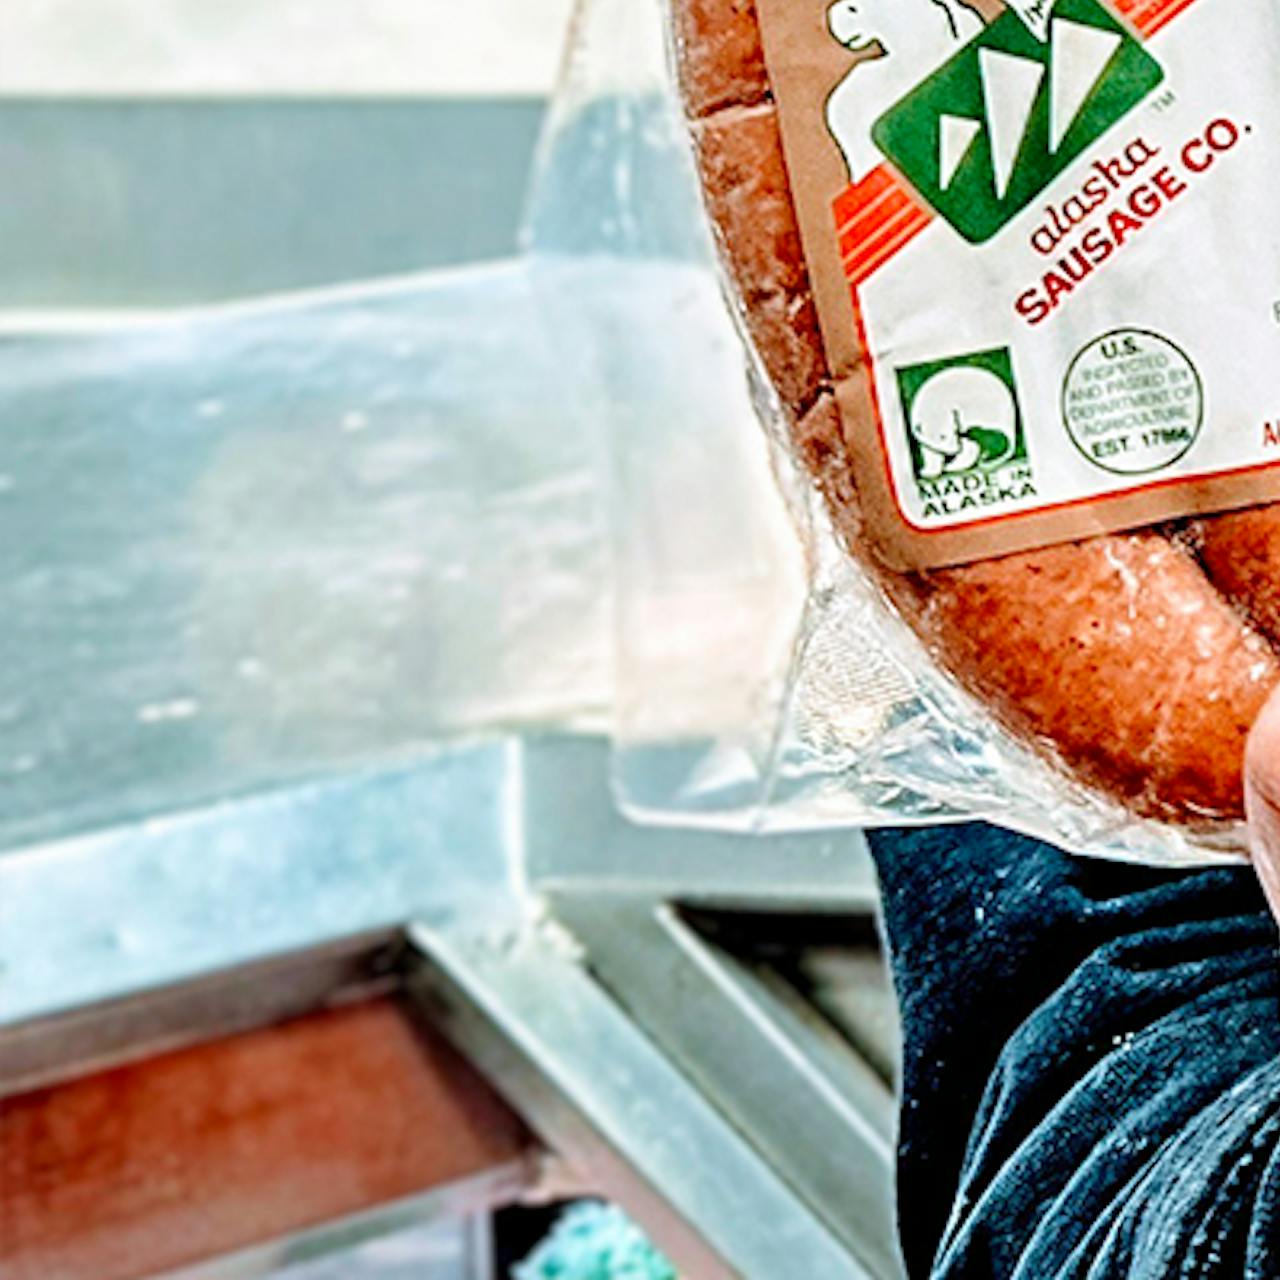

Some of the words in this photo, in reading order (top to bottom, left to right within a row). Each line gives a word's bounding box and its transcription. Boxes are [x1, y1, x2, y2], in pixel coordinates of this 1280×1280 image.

[1150, 89, 1177, 114] TM
[1029, 136, 1161, 256] alaska
[1014, 165, 1188, 326] SAUSAGE
[1180, 117, 1253, 174] CO.
[1101, 336, 1144, 359] U.S.
[919, 471, 999, 500] MADE
[1010, 466, 1032, 481] IN
[922, 482, 1037, 519] ALASKA
